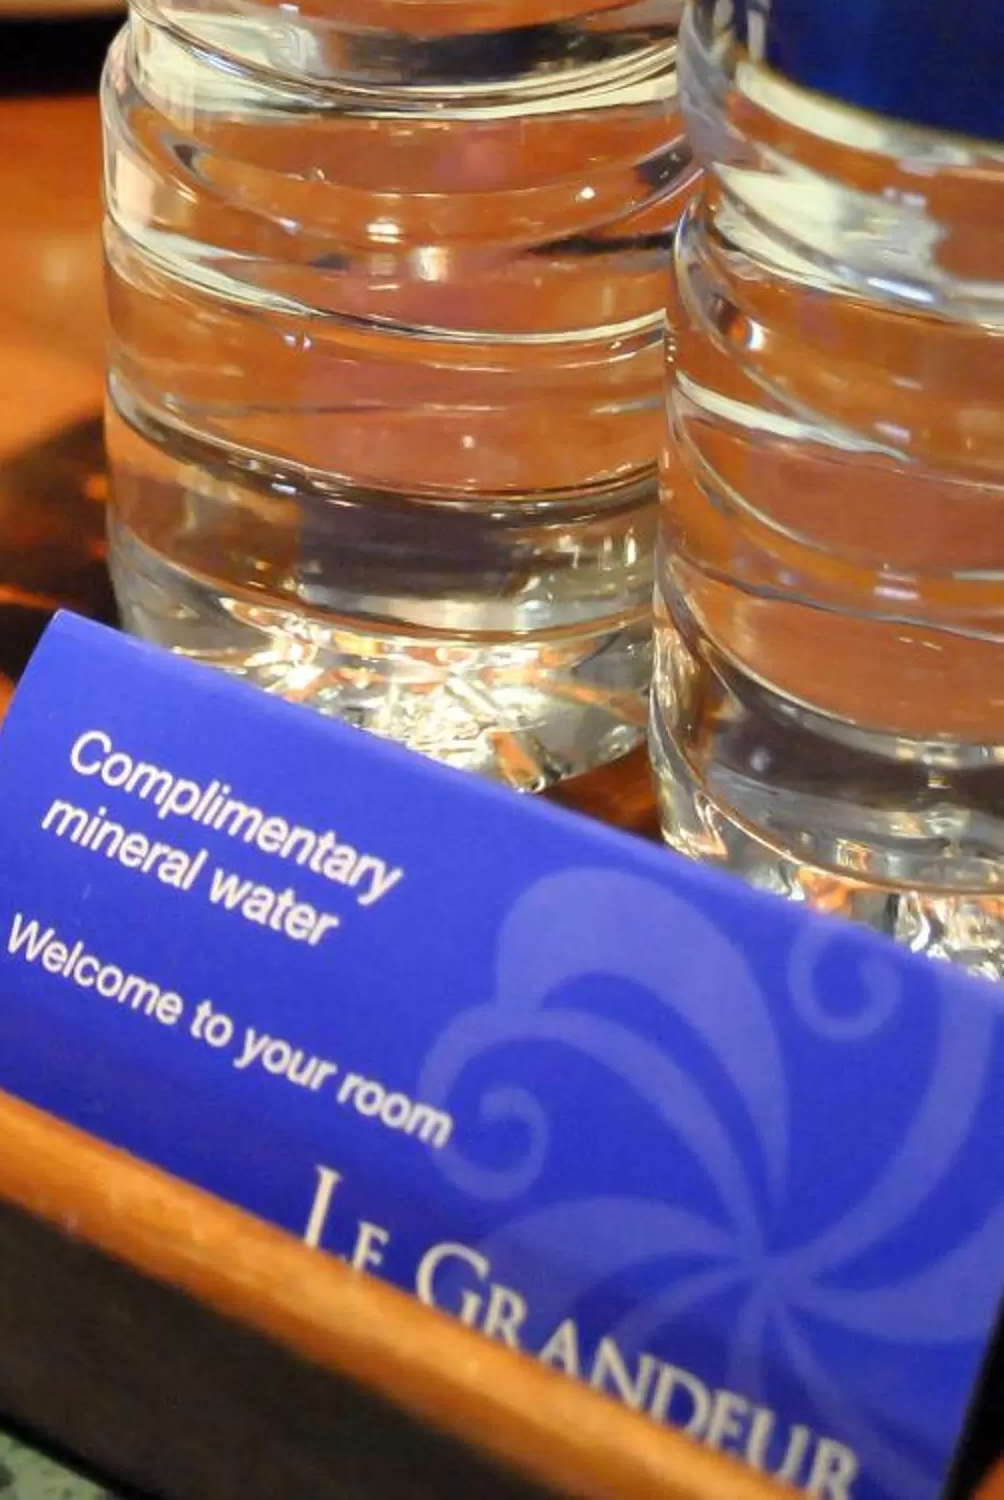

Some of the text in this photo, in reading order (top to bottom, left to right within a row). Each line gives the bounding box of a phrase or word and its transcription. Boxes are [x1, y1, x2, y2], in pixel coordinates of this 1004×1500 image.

[40, 798, 340, 947] mineral water
[69, 730, 404, 907] Complimentary
[6, 913, 455, 1149] Welcome to your room
